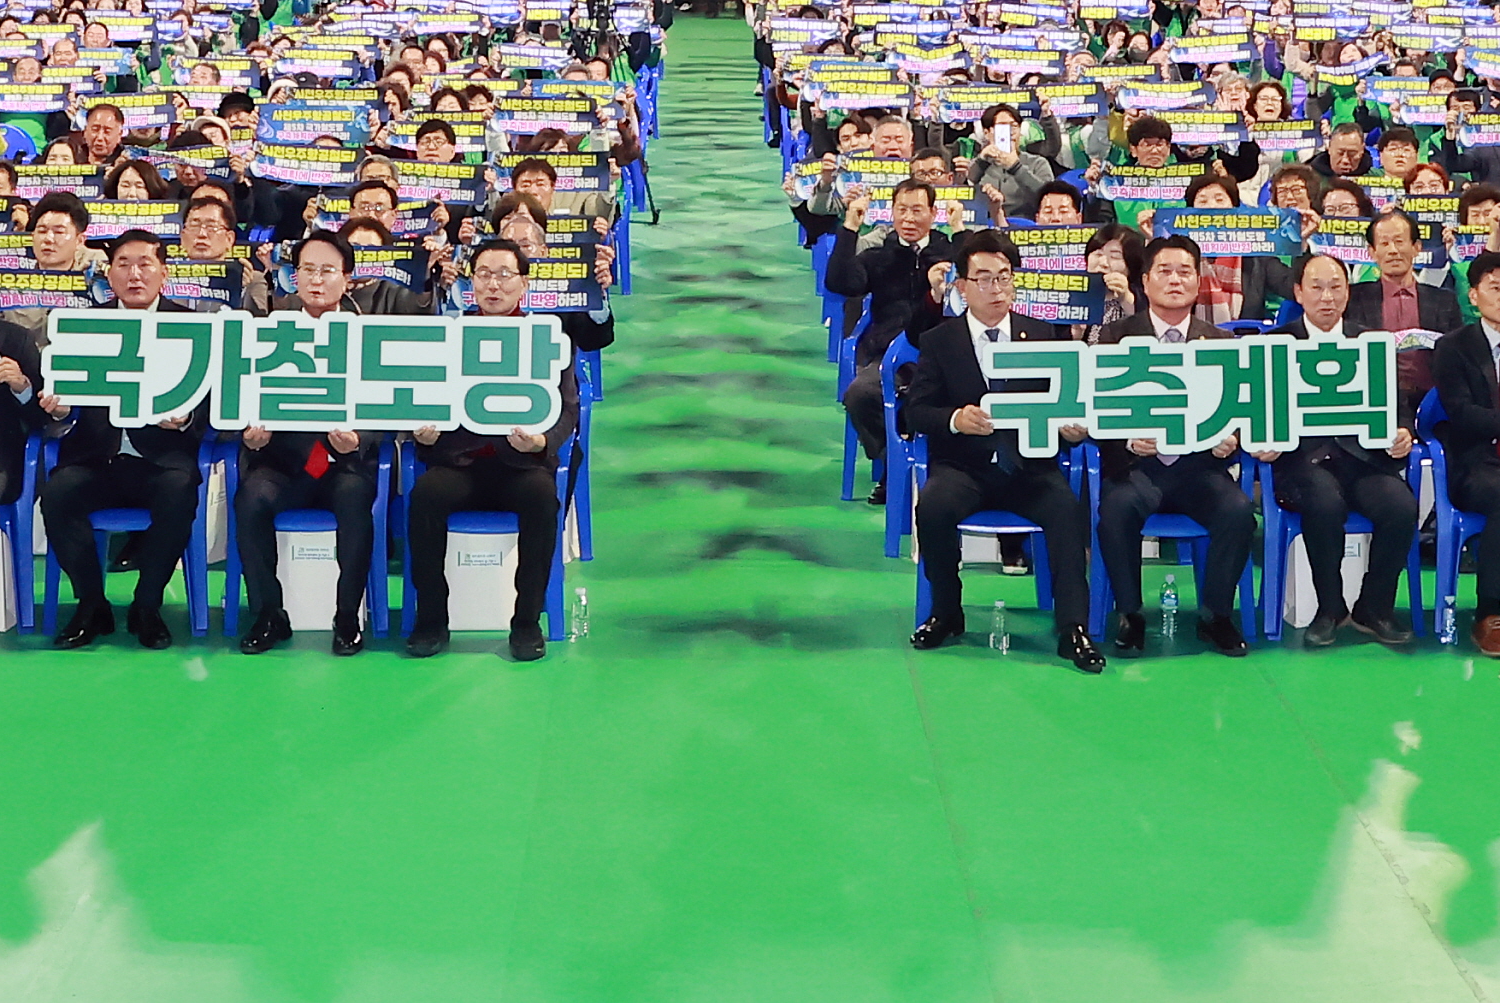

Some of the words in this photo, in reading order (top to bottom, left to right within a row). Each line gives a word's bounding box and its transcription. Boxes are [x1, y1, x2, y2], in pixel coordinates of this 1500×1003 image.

[500, 98, 590, 112] 사천우주항공철도!
[272, 110, 355, 122] 사천우주항공철도!
[262, 145, 356, 162] 사천우주항공철도!
[1174, 215, 1280, 228] 사천우주항공철도!
[1188, 231, 1215, 242] 제5차
[1217, 231, 1266, 241] 국가철도망
[1231, 241, 1275, 253] 반영하라!
[530, 292, 588, 308] 반영하라!
[1031, 302, 1089, 320] 반영하라!
[52, 316, 565, 428] 국가철도망
[988, 341, 1390, 450] 구축계획
